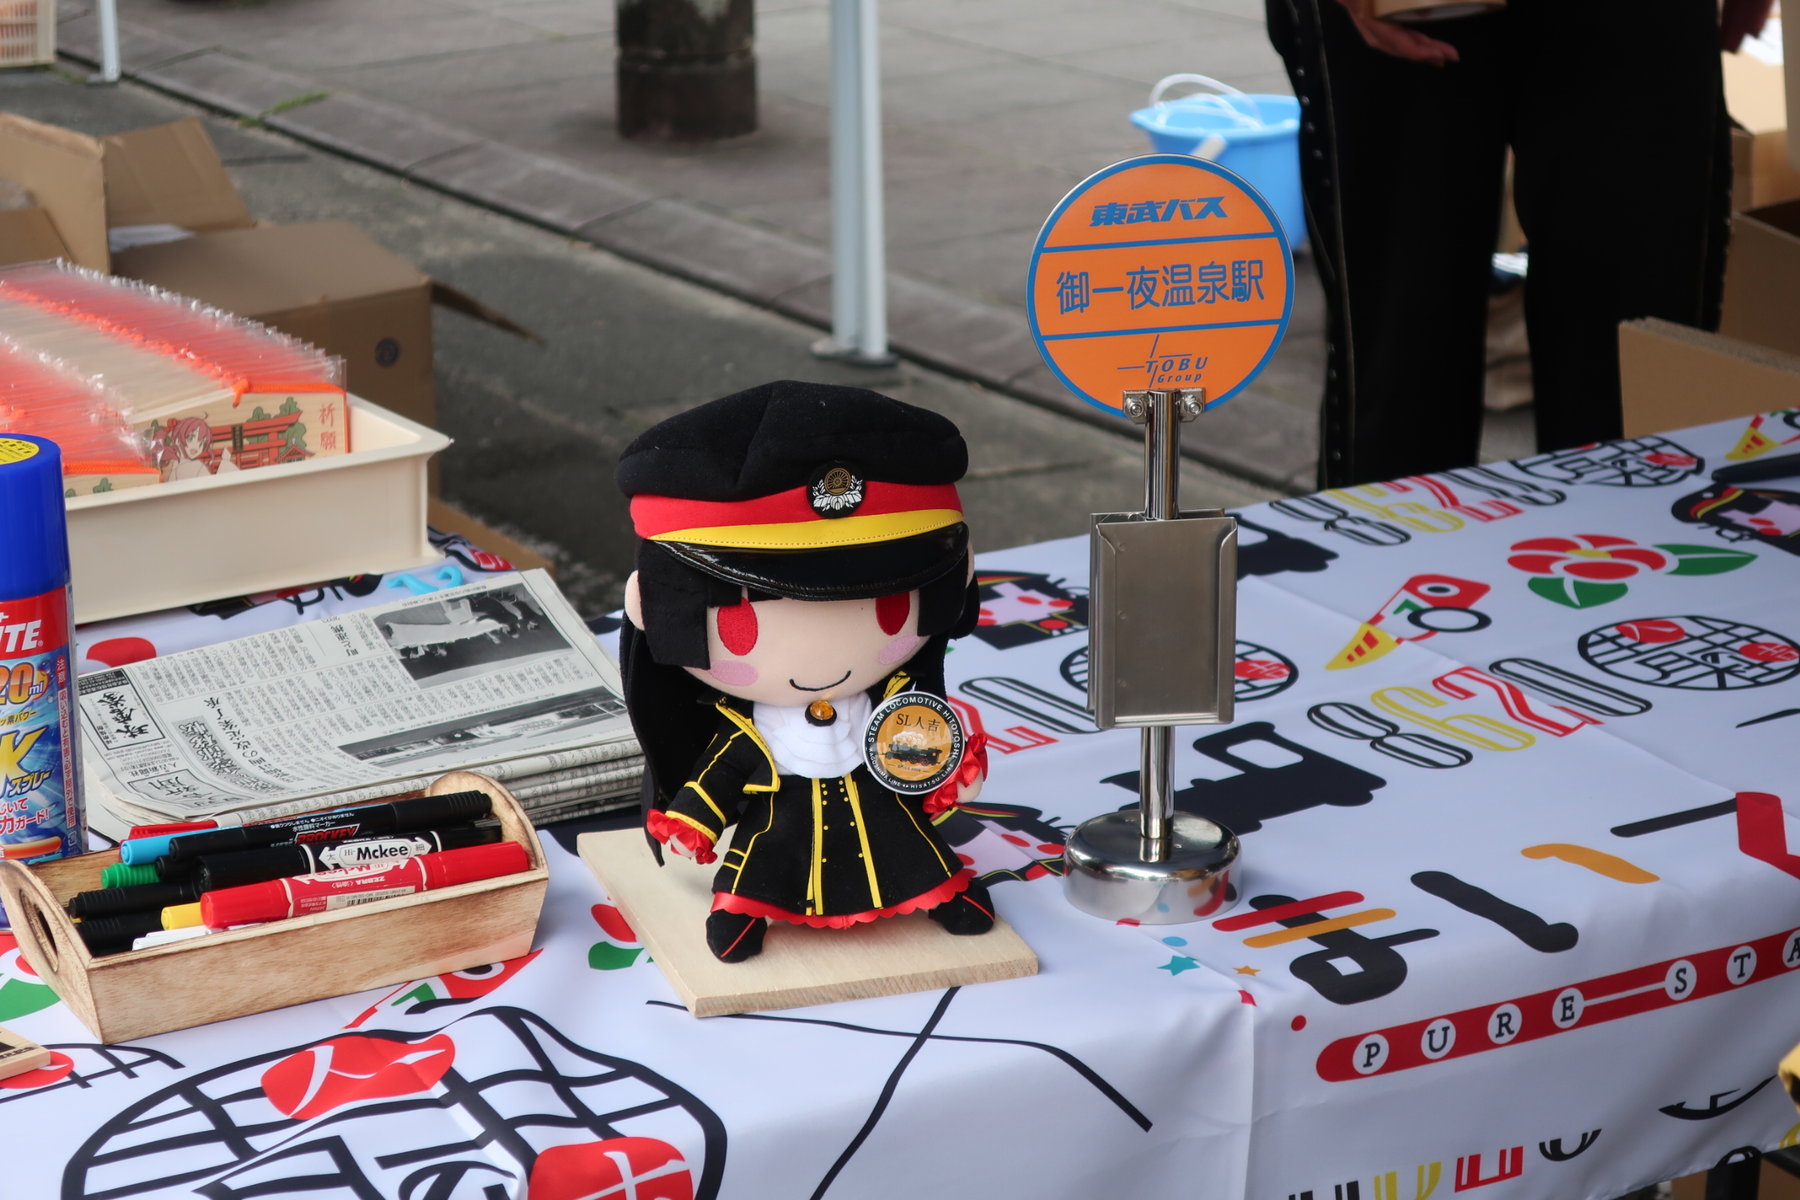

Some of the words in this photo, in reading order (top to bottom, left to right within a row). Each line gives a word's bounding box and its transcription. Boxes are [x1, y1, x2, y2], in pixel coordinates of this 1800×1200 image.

[1089, 196, 1228, 227] 東武バス
[1055, 260, 1265, 315] 御一夜温泉駅
[1144, 355, 1209, 374] TOBU
[1157, 373, 1203, 384] Group
[319, 402, 337, 450] 祈願
[0, 620, 42, 653] TE
[896, 712, 941, 733] SL人吉
[1307, 657, 1652, 769] 8620
[868, 713, 886, 743] STEAM
[884, 696, 943, 714] LOCOMOTIVE
[942, 709, 962, 760] HITOYOSHI
[9, 770, 52, 798] スプレー
[910, 776, 941, 789] HISATSU
[356, 844, 409, 861] Mckee
[355, 876, 386, 885] ZEBRA
[1361, 992, 1577, 1069] PURE
